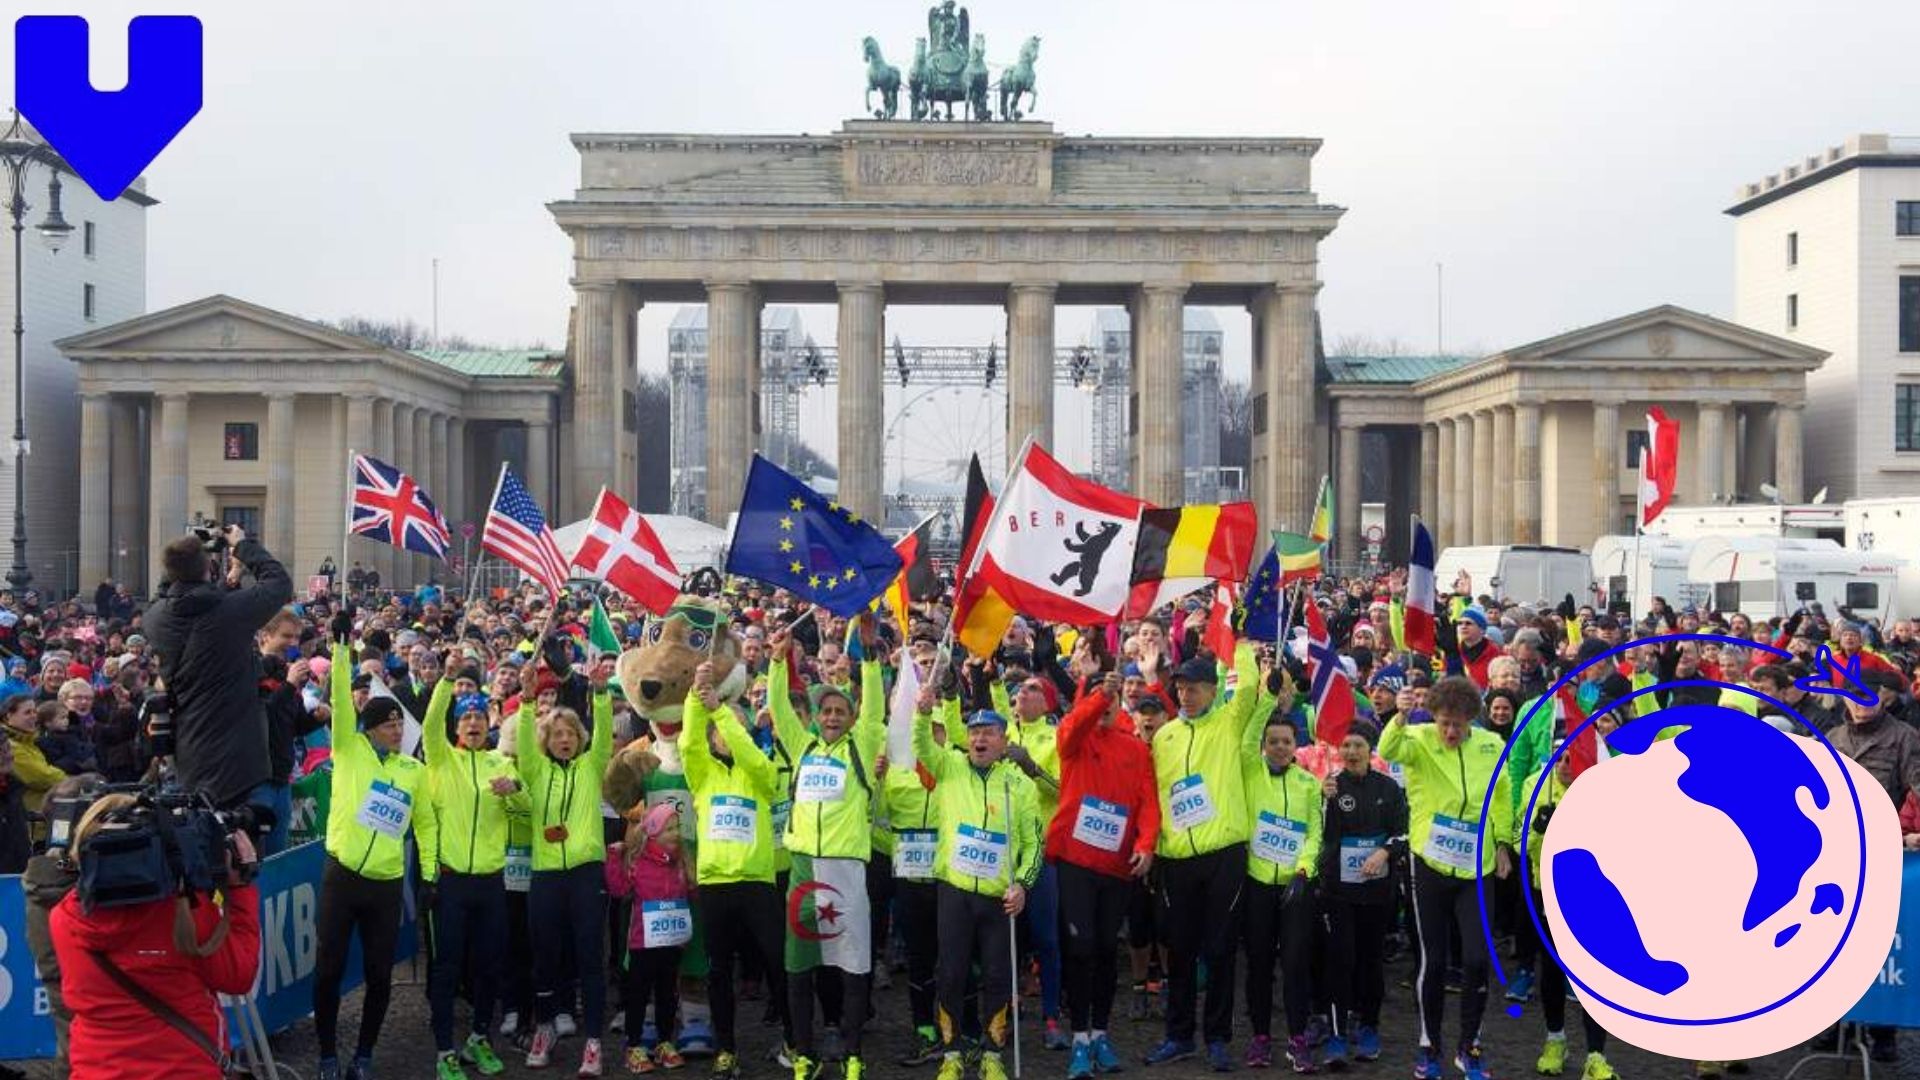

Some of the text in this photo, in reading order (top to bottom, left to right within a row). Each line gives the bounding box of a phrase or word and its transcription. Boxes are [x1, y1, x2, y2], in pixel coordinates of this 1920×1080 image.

[804, 773, 838, 788] 2016
[367, 800, 404, 824] 2016
[1171, 798, 1204, 816] 2016
[715, 813, 751, 828] 2016
[1083, 816, 1119, 835] 2016
[1260, 830, 1299, 853] 2016
[1434, 834, 1474, 855] 2016
[959, 845, 998, 865] 2016
[651, 917, 687, 932] 2016
